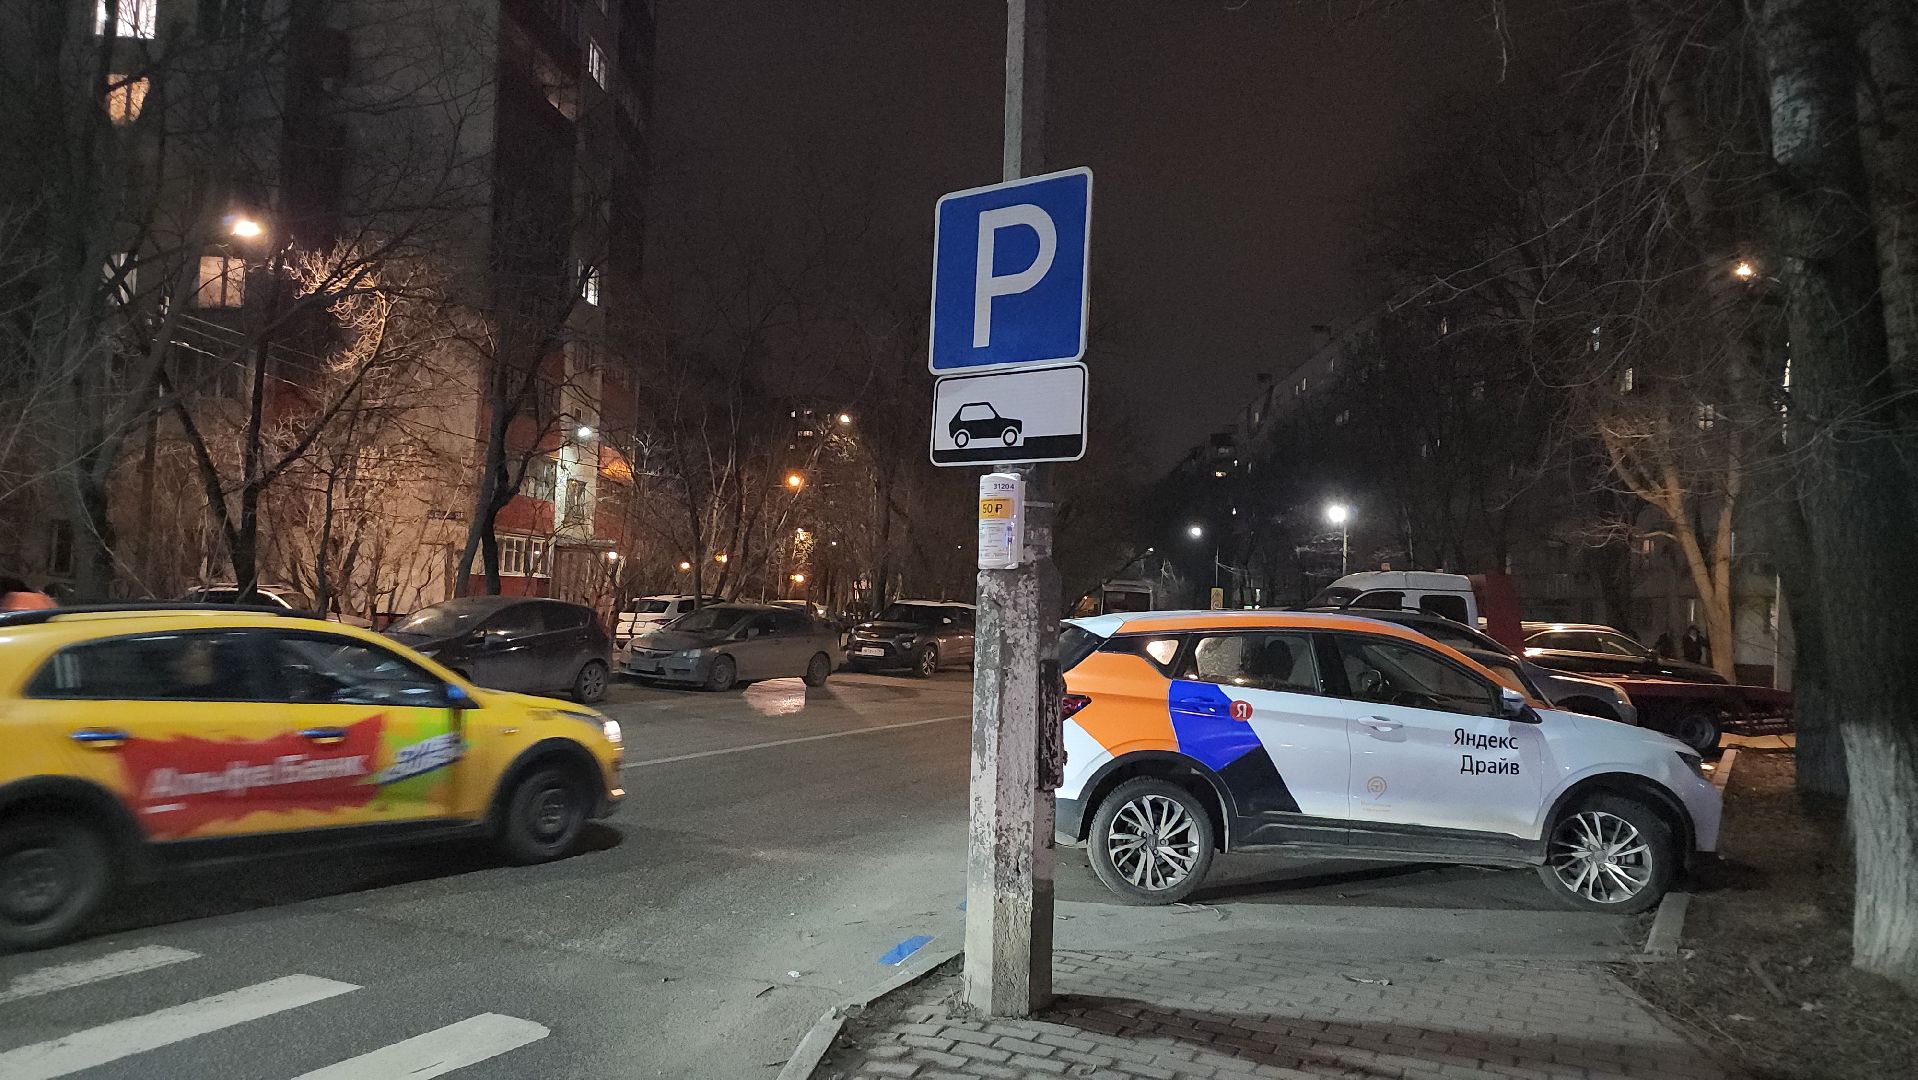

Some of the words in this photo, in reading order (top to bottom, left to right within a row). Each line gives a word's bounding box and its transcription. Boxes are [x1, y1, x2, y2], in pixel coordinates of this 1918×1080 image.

[973, 204, 1057, 348] P
[982, 503, 993, 514] 50
[1236, 703, 1247, 718] Я
[1454, 728, 1519, 750] Яндекс
[1460, 755, 1520, 775] Драйв
